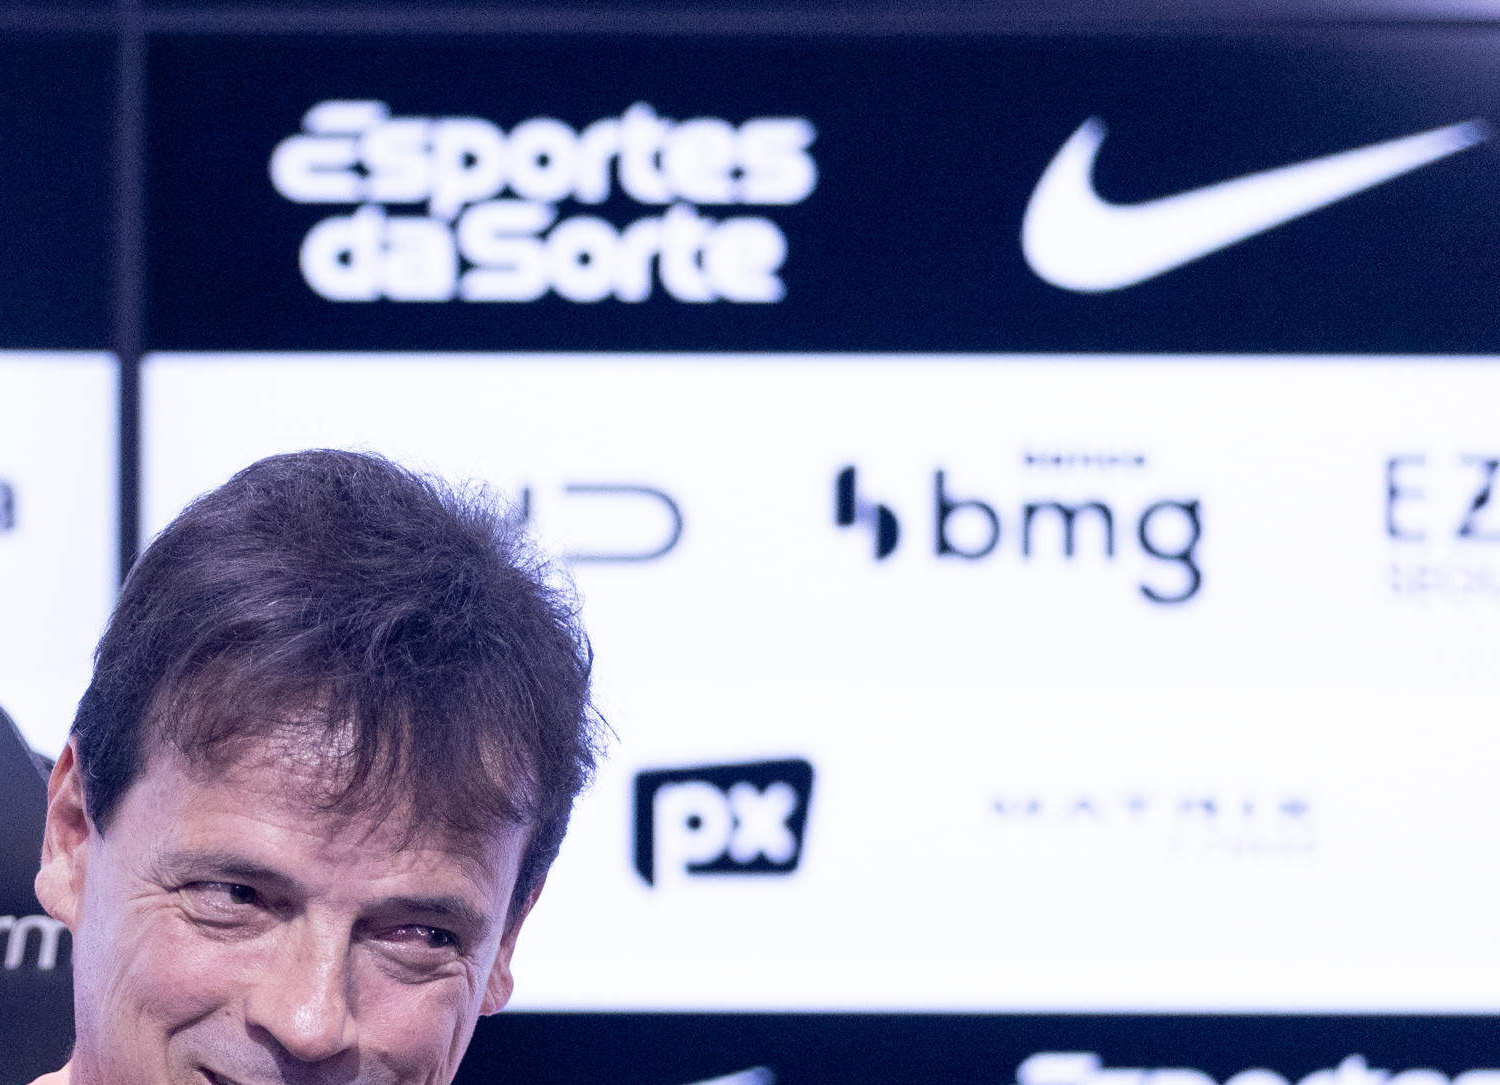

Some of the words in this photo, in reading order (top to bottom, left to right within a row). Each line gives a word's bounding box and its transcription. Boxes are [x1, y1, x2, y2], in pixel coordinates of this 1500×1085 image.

[272, 102, 816, 220] Esportes
[933, 469, 1204, 606] bmg
[652, 780, 799, 885] px
